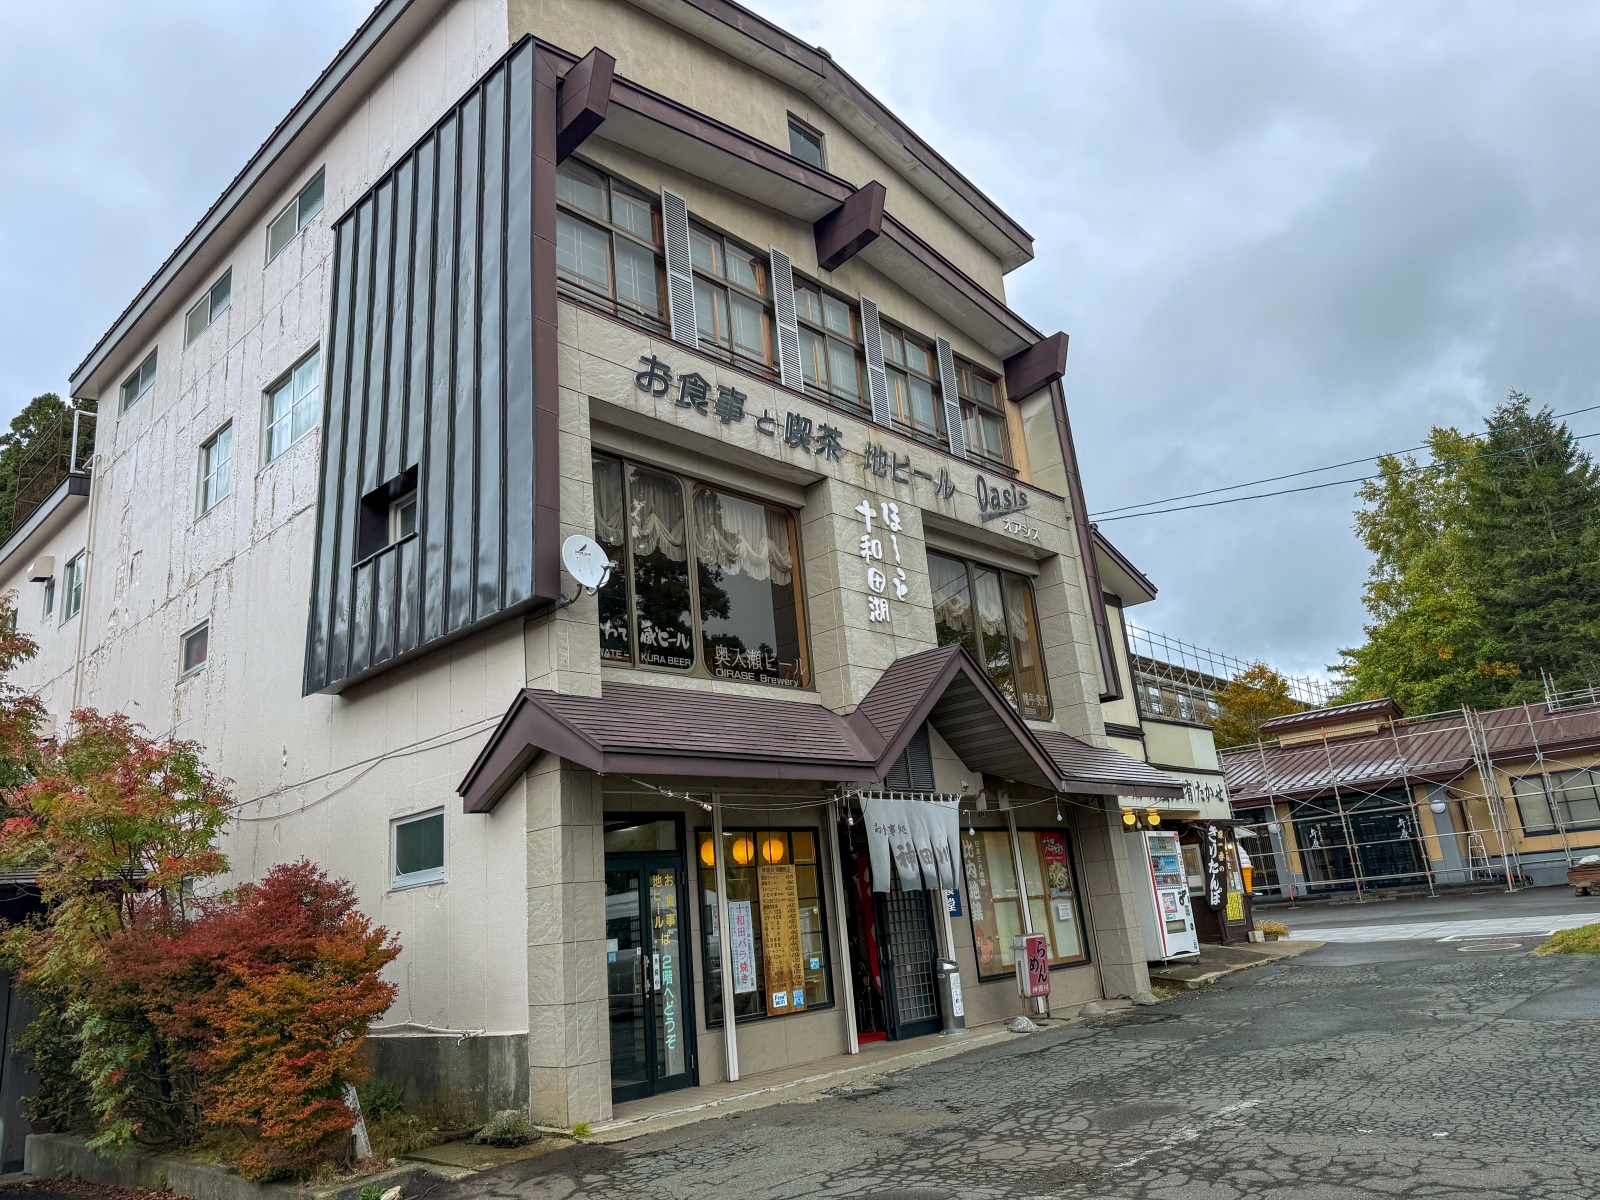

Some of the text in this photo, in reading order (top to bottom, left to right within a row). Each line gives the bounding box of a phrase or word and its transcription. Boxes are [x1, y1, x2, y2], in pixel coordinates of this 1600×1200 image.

[863, 440, 956, 500] 地ビール
[975, 474, 1028, 513] Oasis
[1002, 518, 1041, 543] オアシス
[854, 500, 890, 622] 十和田湖
[641, 652, 666, 664] KURA
[667, 656, 691, 667] BEER
[715, 644, 807, 676] 奥入瀬ビール
[715, 668, 799, 687] OIRASE Brewery
[895, 841, 950, 873] 神田川
[961, 839, 984, 922] 比内地鶏
[1207, 825, 1223, 906] きりたんぽ
[652, 874, 665, 929] 地ビール
[735, 903, 749, 984] 十和田バラ焼き
[662, 954, 677, 1050] 2階へどうぞ
